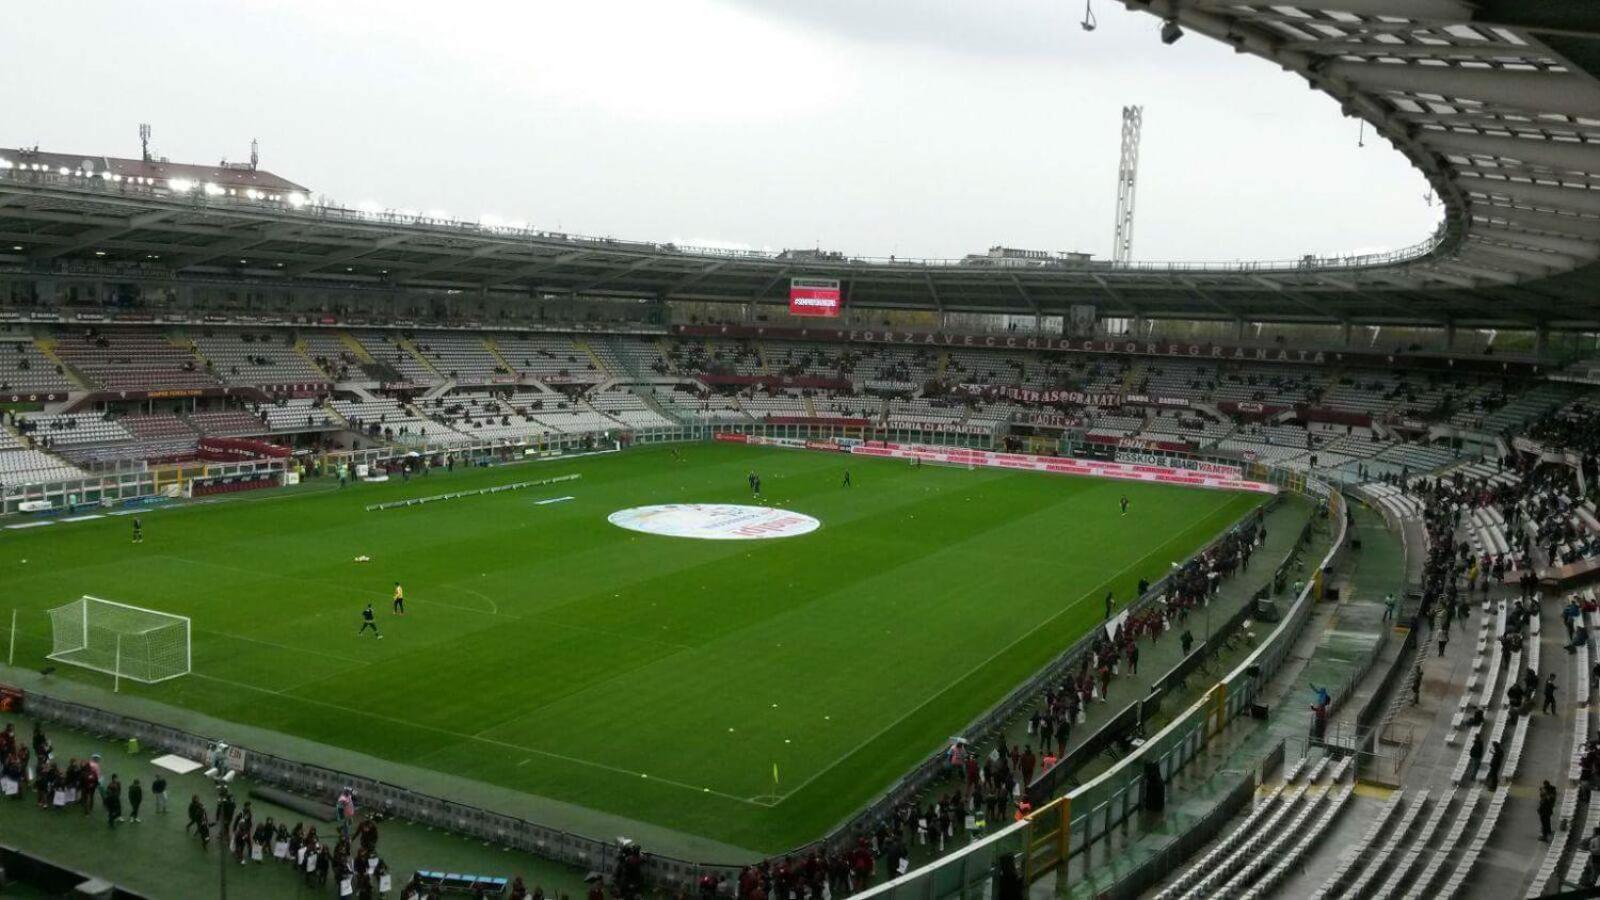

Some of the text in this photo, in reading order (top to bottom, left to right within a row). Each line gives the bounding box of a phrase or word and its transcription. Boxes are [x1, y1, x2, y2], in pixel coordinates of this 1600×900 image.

[850, 331, 1326, 363] FORZA VECCHIO CUORE GRANATA
[1008, 388, 1059, 402] ULTRAS
[1069, 391, 1120, 407] GRANATA
